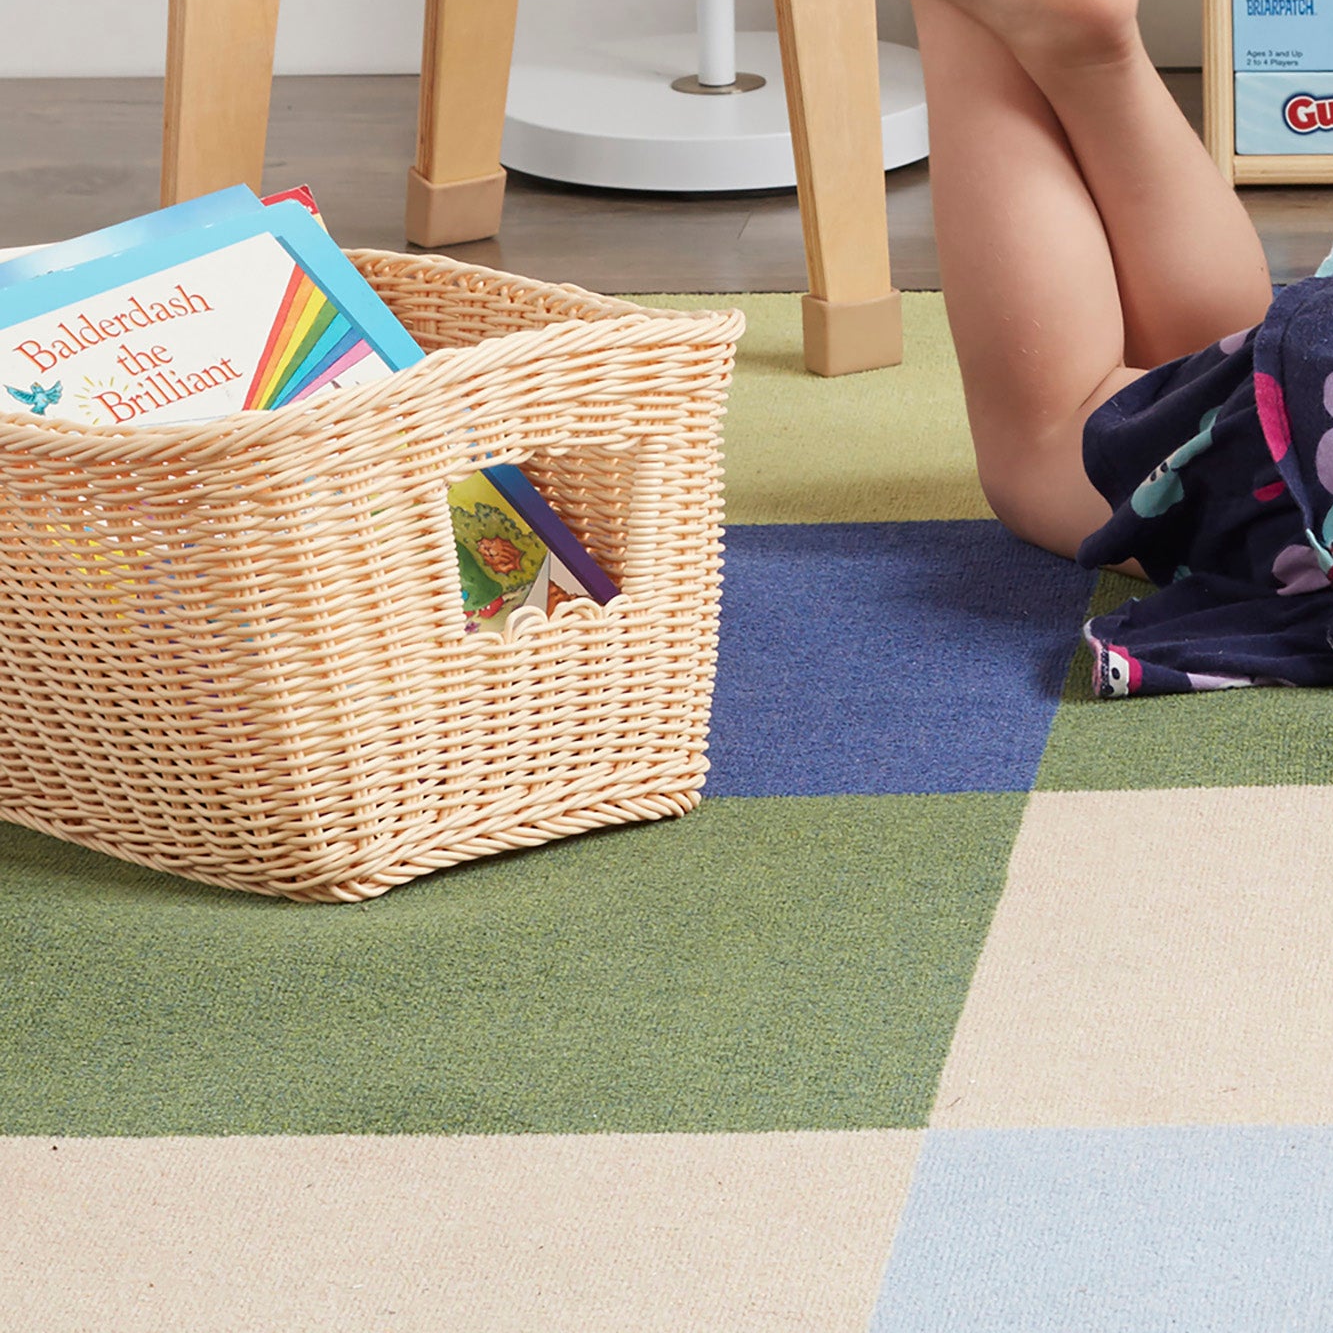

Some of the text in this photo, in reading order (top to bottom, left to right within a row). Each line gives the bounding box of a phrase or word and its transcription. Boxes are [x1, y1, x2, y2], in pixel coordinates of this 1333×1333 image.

[1246, 49, 1303, 60] Ages 3 and Up
[1246, 58, 1299, 68] 2 to 4 Players
[12, 285, 215, 374] Balderdash
[115, 343, 174, 378] the
[93, 356, 243, 425] Brilliant
